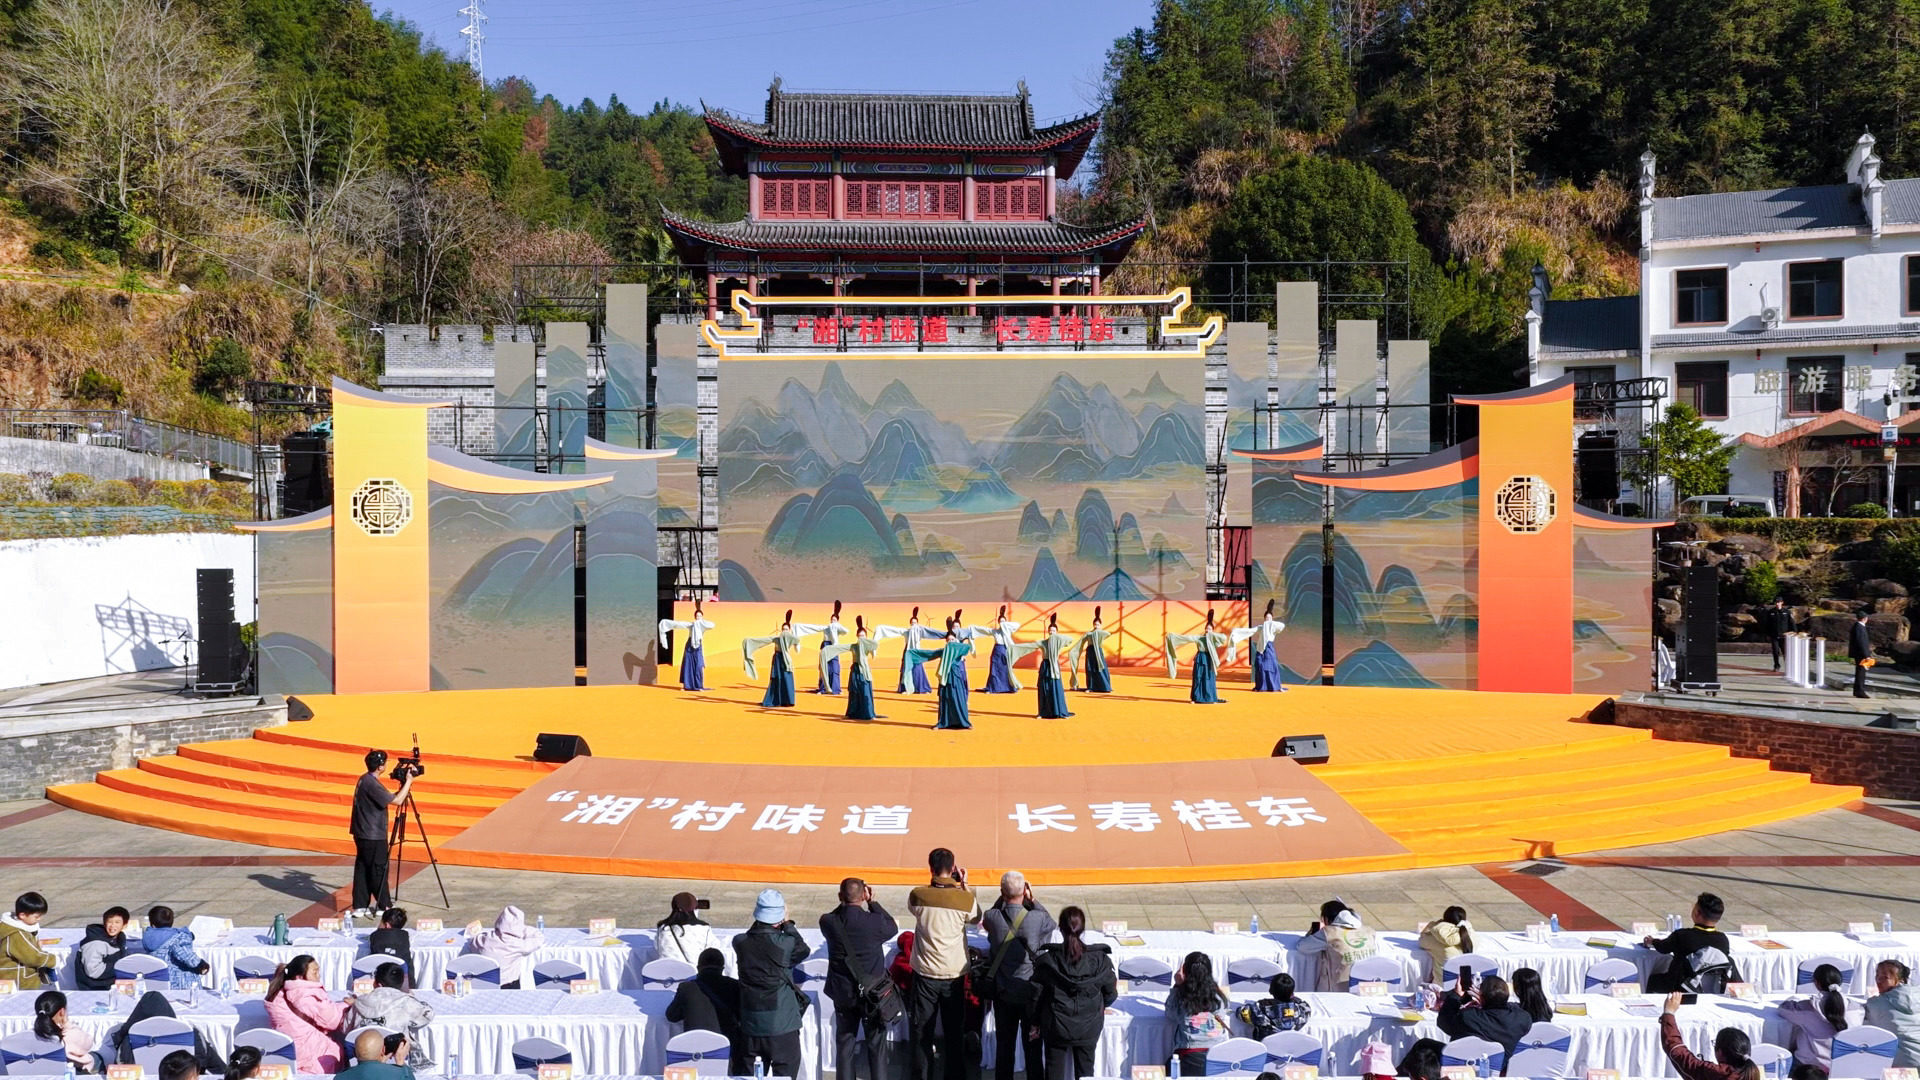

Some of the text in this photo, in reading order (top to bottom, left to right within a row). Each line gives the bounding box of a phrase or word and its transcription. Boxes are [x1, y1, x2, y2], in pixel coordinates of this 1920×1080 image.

[995, 315, 1115, 343] 长寿桂东
[1754, 364, 1920, 396] 旅游服务
[546, 790, 1328, 834] “湘”村味道 长寿桂东
